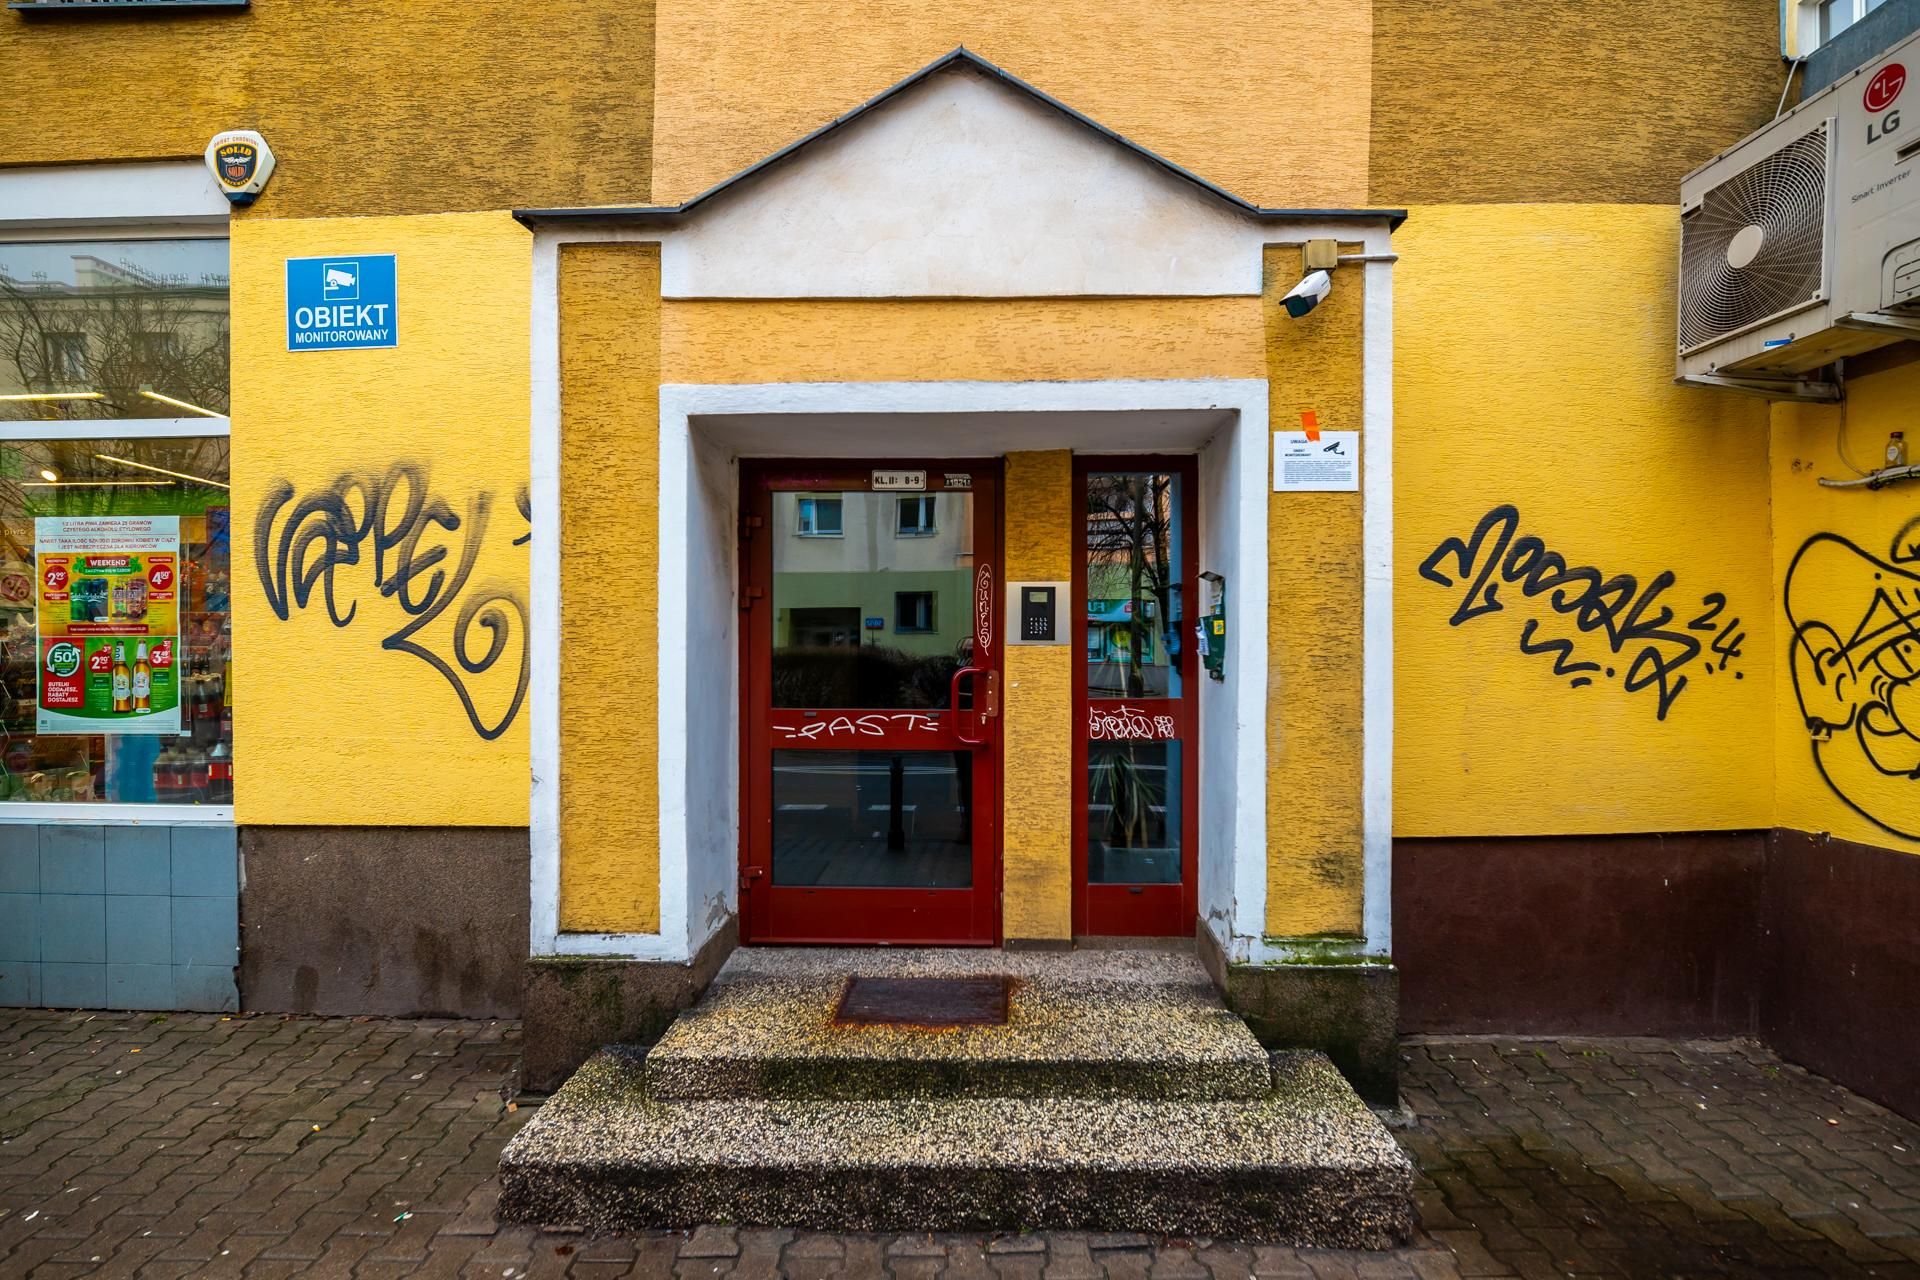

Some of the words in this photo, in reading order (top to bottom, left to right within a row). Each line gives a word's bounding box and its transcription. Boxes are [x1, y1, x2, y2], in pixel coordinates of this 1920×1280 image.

[1867, 110, 1900, 145] LG
[220, 145, 252, 157] SOLID
[1852, 187, 1875, 203] Smart
[1876, 169, 1911, 191] Inverter
[295, 304, 389, 328] OBIEKT
[295, 329, 389, 343] MONITOROWANY
[905, 476, 920, 485] 8-9
[90, 559, 126, 567] WEEKEND
